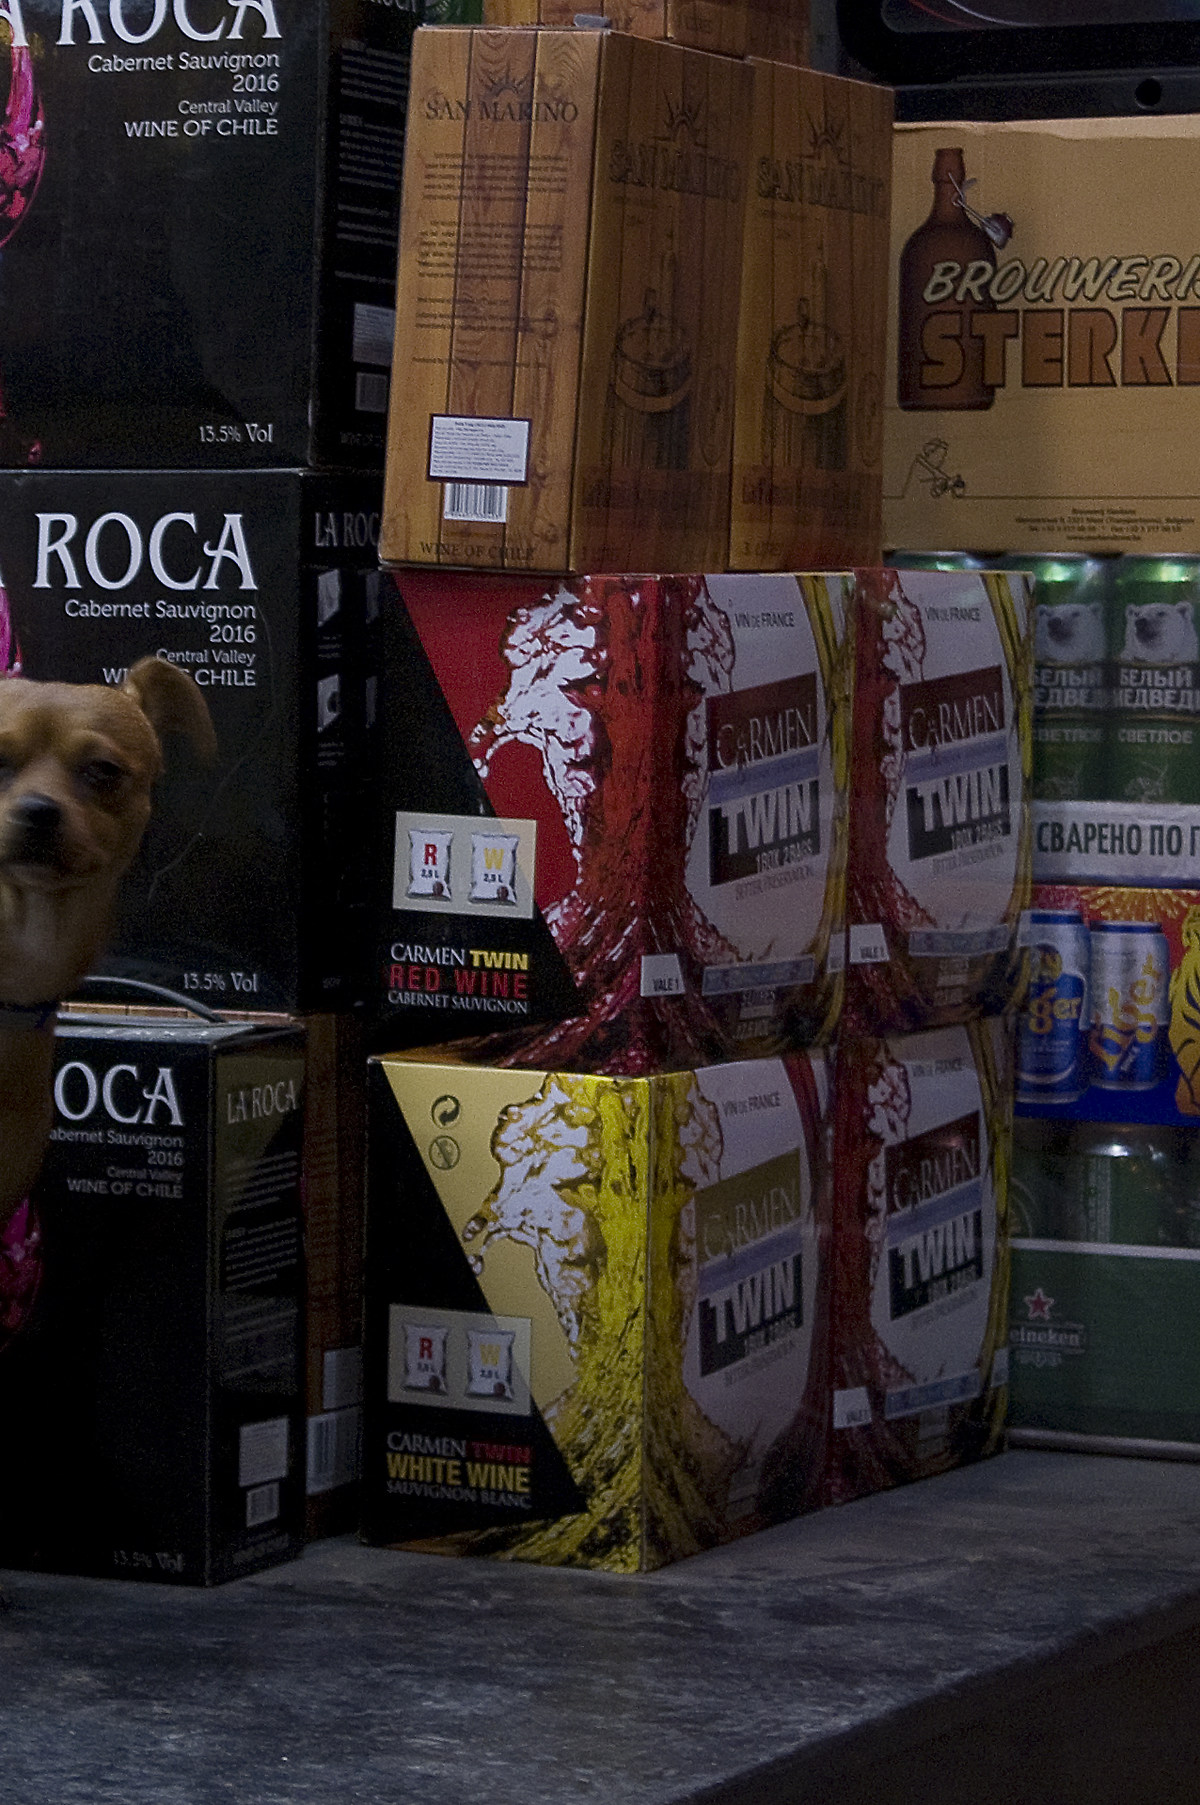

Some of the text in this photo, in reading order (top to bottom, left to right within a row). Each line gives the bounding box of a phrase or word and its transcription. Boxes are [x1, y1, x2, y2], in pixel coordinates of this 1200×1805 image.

[88, 52, 280, 77] Cabernet Sauvignon
[232, 74, 280, 93] 2016
[178, 99, 279, 117] Central Valley
[425, 99, 579, 123] SAN MARINO
[123, 118, 278, 138] WINE OF CHILE
[199, 422, 273, 444] 13.5% Vol
[314, 512, 338, 547] LA
[31, 511, 259, 591] ROCA
[420, 541, 459, 556] WINE
[64, 598, 256, 623] Cabernet Sauvignon
[761, 611, 795, 629] FRANCE
[210, 625, 256, 644] 2016
[156, 648, 256, 667] Central Valley
[195, 668, 256, 687] CHILE
[1119, 666, 1193, 688] БЕЛЫЙ
[1118, 727, 1194, 744] СВЕТЛОЕ
[917, 766, 1002, 832] TWIN
[721, 780, 812, 855] TWIN
[1036, 820, 1142, 855] СВАРЕНО
[1150, 824, 1182, 856] ПО
[424, 843, 438, 866] R
[483, 847, 505, 870] W
[390, 942, 529, 972] CARMEN TWIN
[182, 971, 259, 994] 13.5% Vol
[389, 963, 529, 999] RED WINE
[653, 979, 673, 992] VALE
[387, 989, 529, 1015] CABERNET SAUVIGNON
[53, 1060, 187, 1127] OCA
[226, 1079, 298, 1125] LA ROCA
[49, 1125, 184, 1150] abernet Sauvignon
[147, 1150, 184, 1168] 2016
[67, 1177, 184, 1199] WINE OF CHILE
[899, 1210, 976, 1290] TWIN
[709, 1258, 795, 1344] TWIN
[1009, 1322, 1082, 1347] eineken
[419, 1337, 433, 1360] R
[479, 1343, 501, 1367] W
[386, 1431, 531, 1464] CARMEN TWIN
[385, 1451, 531, 1493] WHITE WINE
[385, 1479, 532, 1510] SAUVIGNON BLANC
